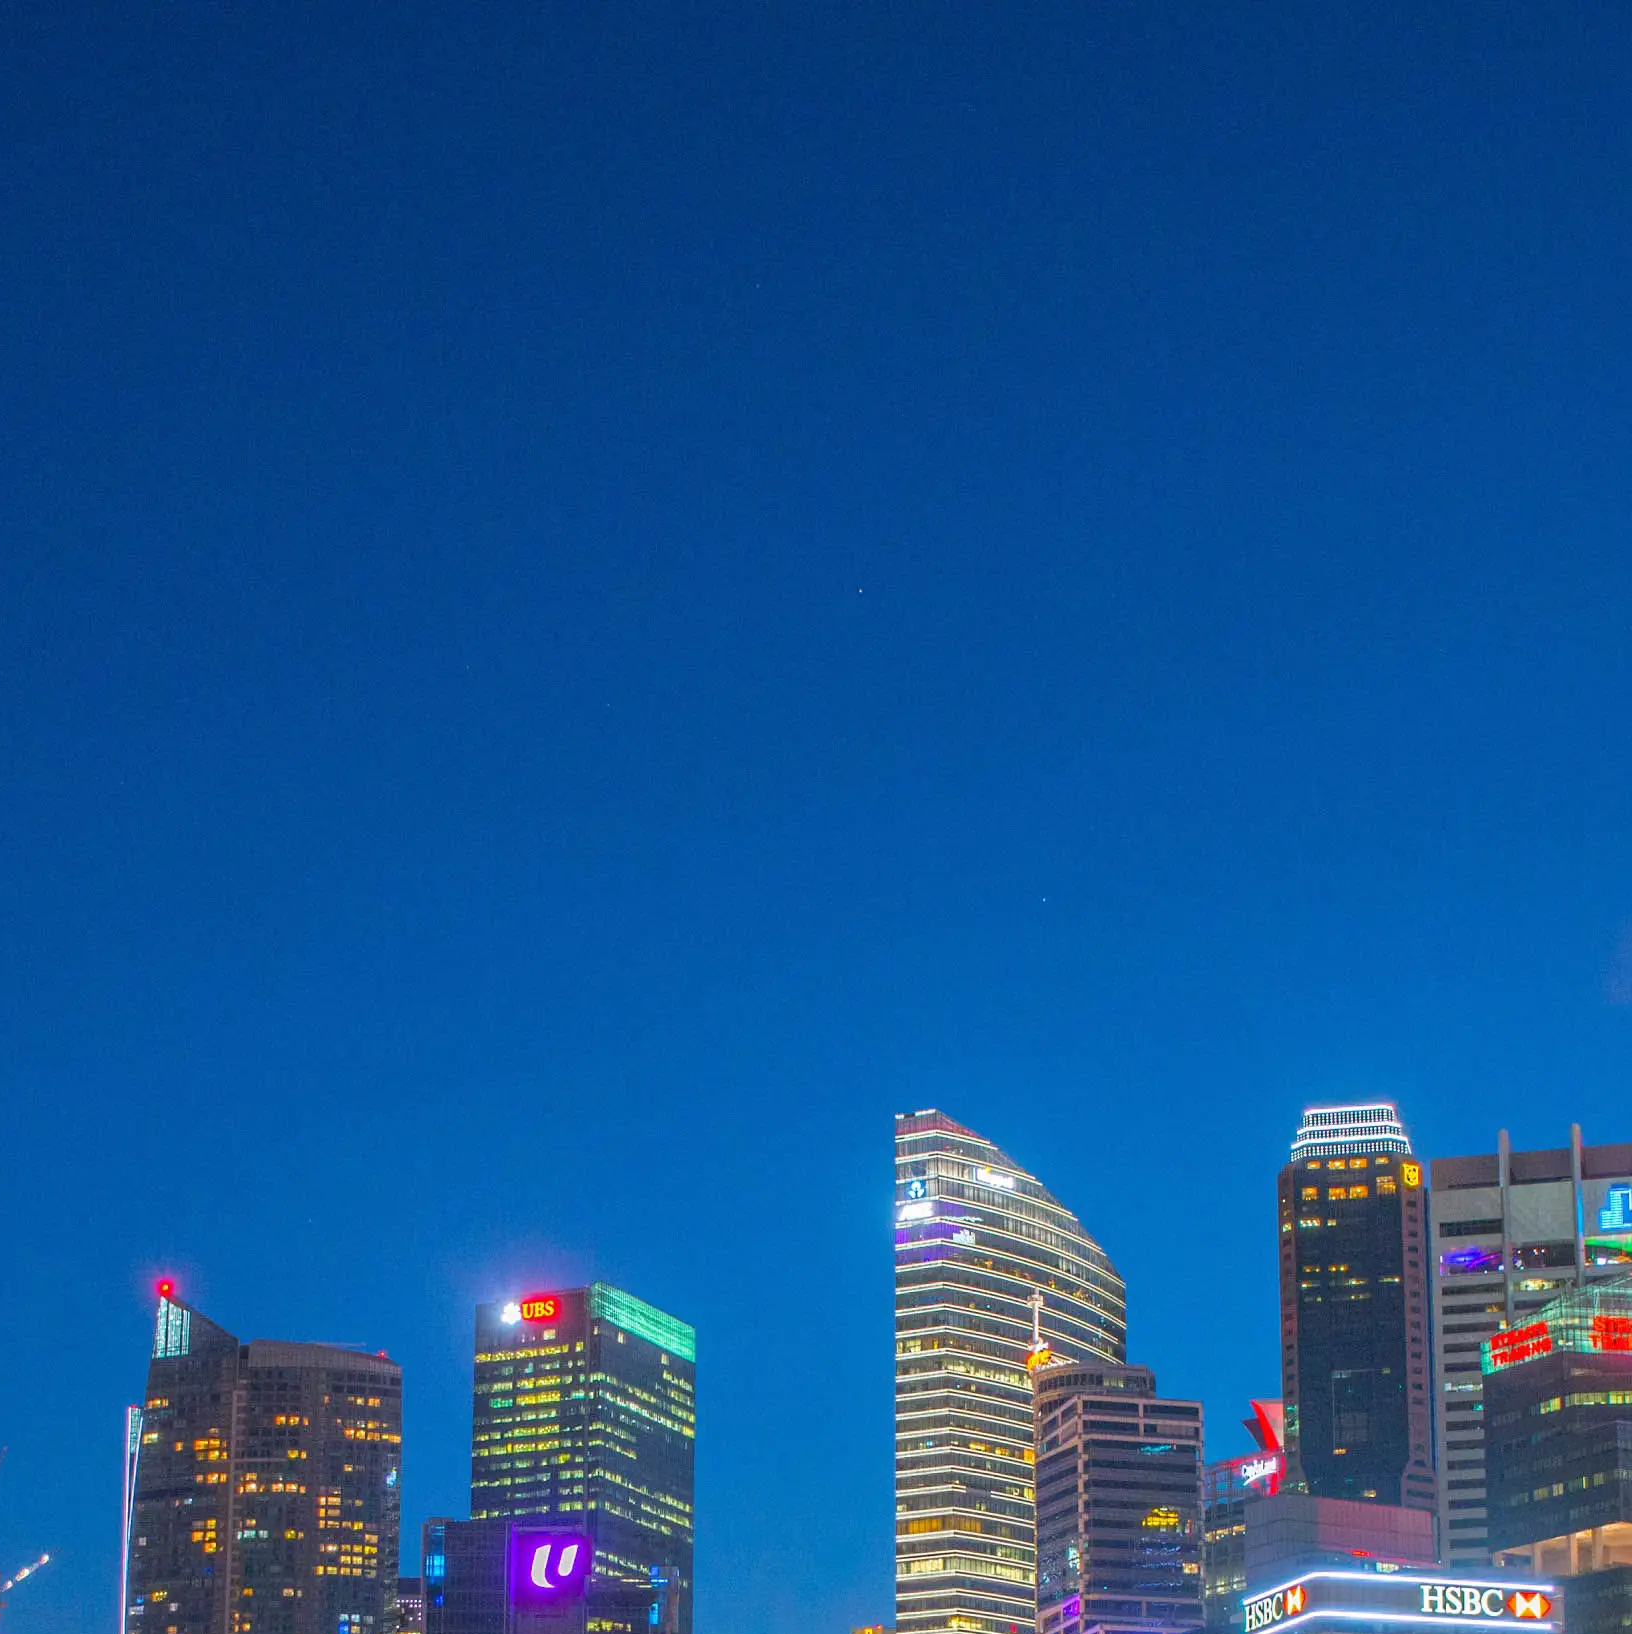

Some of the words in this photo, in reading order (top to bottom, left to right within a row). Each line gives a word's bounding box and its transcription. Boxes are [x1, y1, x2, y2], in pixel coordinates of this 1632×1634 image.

[521, 1300, 555, 1319] UBS
[1244, 1592, 1283, 1632] HSBC
[1420, 1584, 1504, 1616] HSBC
